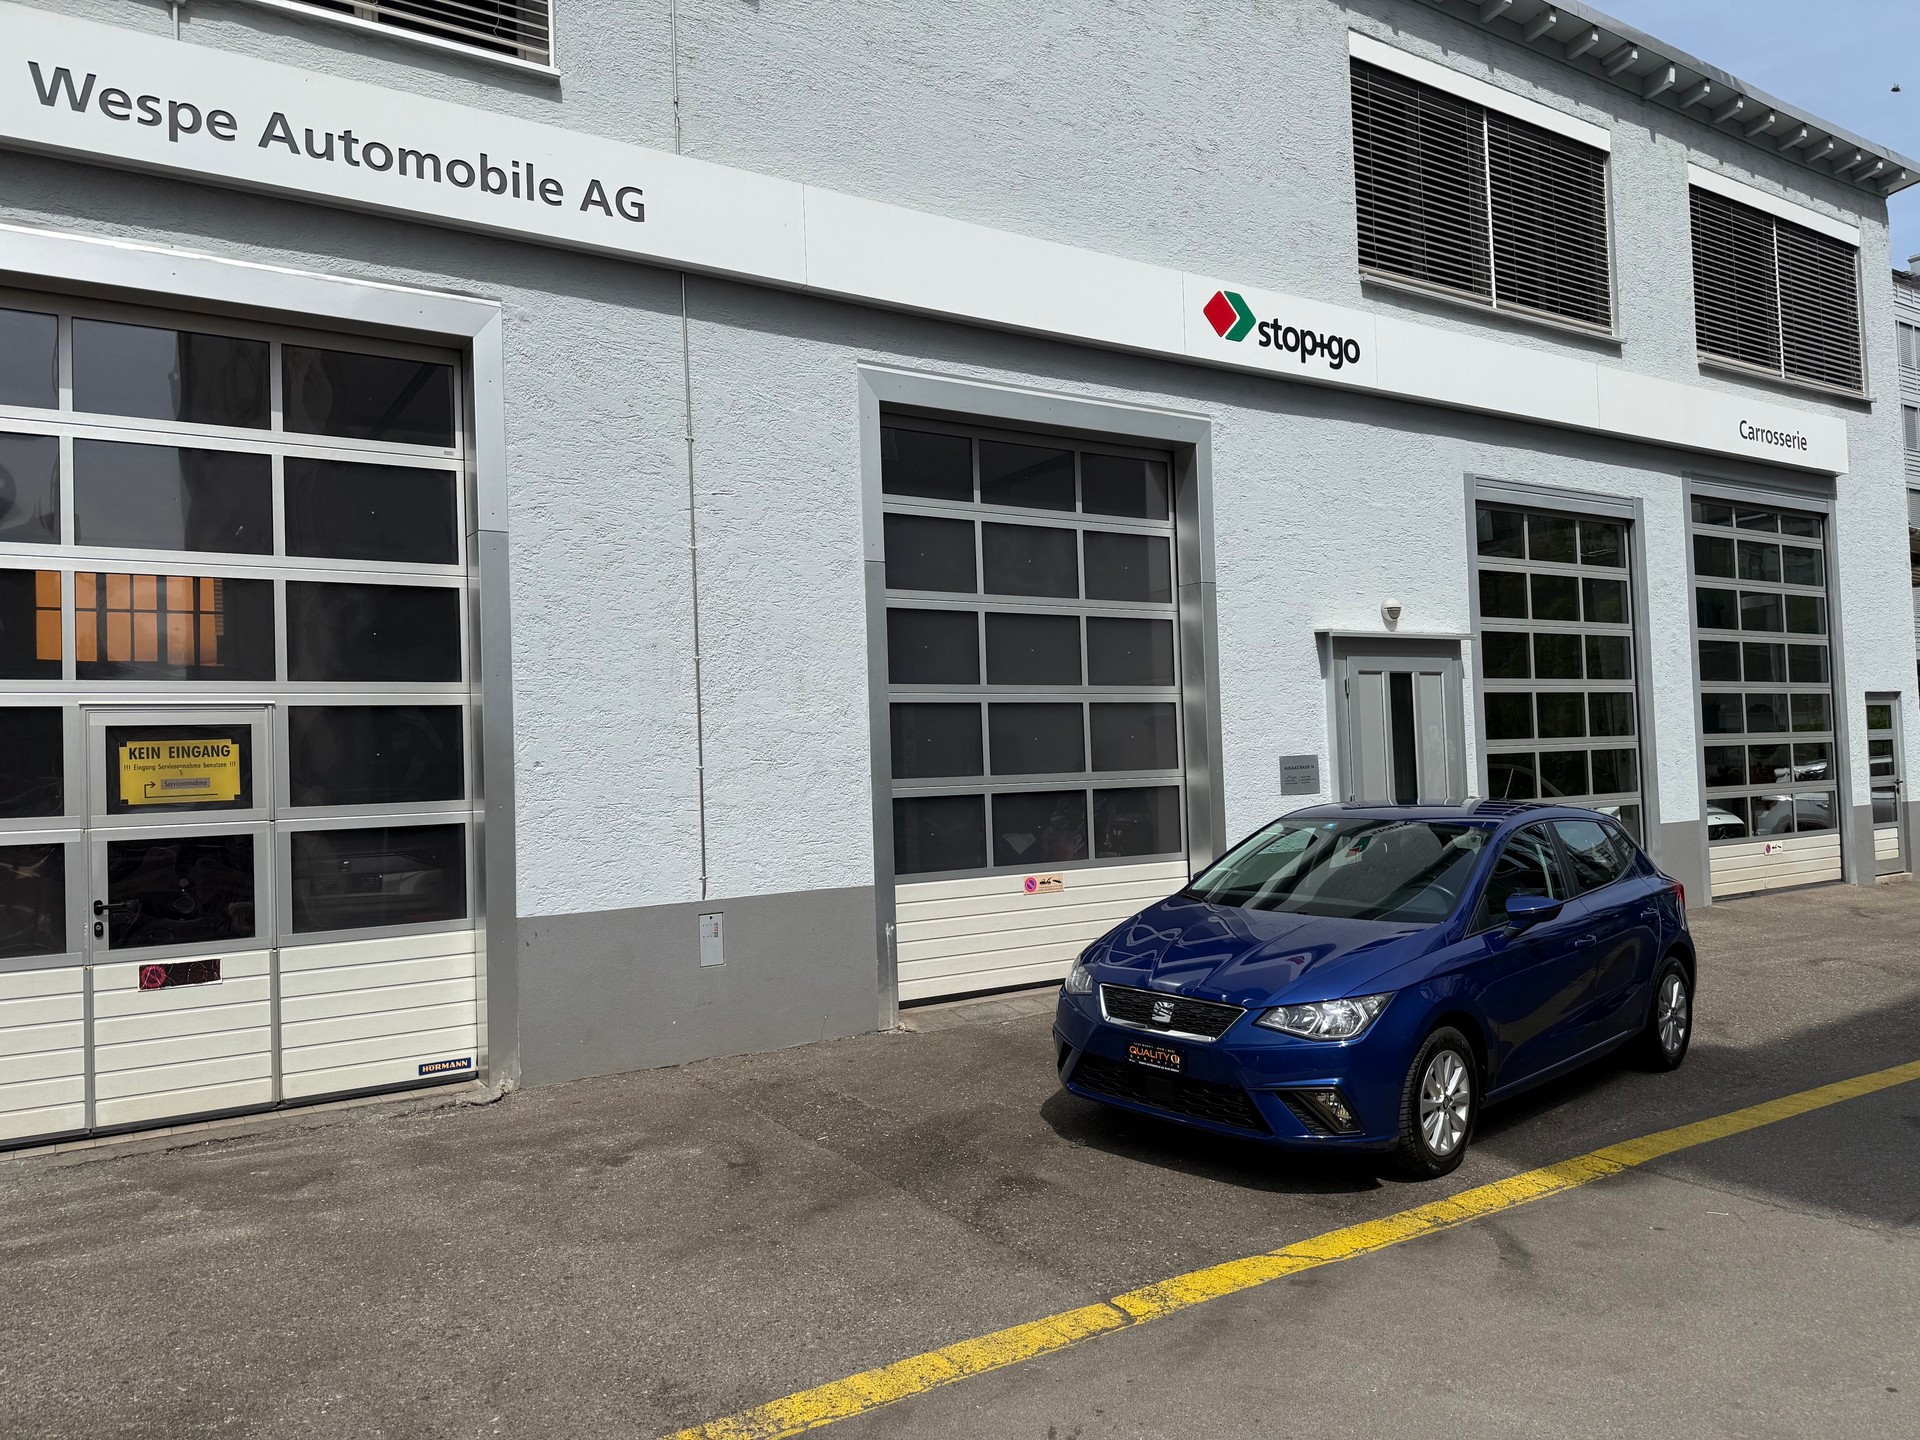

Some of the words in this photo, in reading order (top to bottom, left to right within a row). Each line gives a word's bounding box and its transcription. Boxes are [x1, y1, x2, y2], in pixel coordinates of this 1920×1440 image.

[28, 61, 237, 143] Wespe
[258, 112, 564, 207] Automobile
[580, 179, 645, 223] AG
[1258, 318, 1361, 370] stop+go
[1739, 419, 1808, 451] Carrosserie
[129, 747, 161, 760] KEIN
[168, 745, 231, 759] EINGANG
[158, 762, 201, 770] Serviceannahme
[203, 761, 227, 769] benutzen
[164, 780, 208, 788] Serviceannahme
